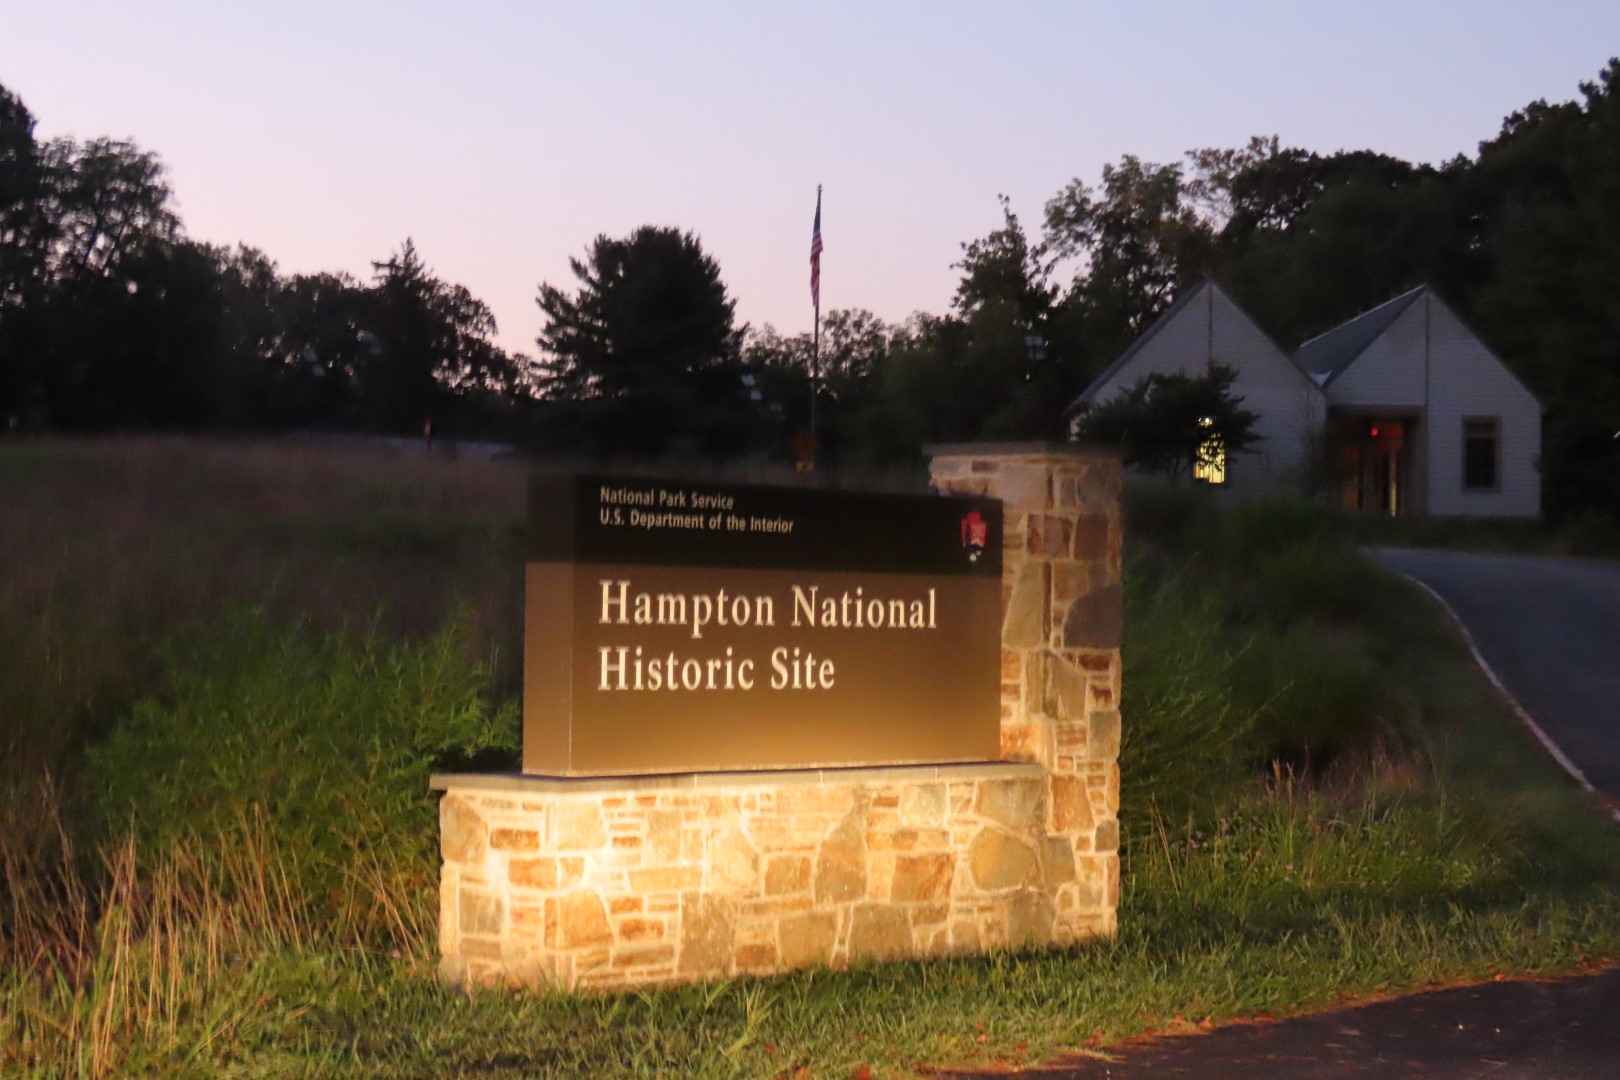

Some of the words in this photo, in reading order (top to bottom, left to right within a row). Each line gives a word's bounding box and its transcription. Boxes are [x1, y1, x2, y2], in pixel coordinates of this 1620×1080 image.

[600, 485, 654, 506] National
[659, 488, 686, 508] Park
[691, 491, 734, 510] Service
[600, 507, 625, 526] U.S.
[630, 508, 705, 530] Department
[708, 512, 722, 530] of
[726, 514, 746, 531] the
[750, 515, 794, 533] Interior
[599, 579, 775, 639] Hampton
[790, 585, 938, 629] National
[598, 645, 756, 692] Historic
[770, 646, 836, 690] Site
